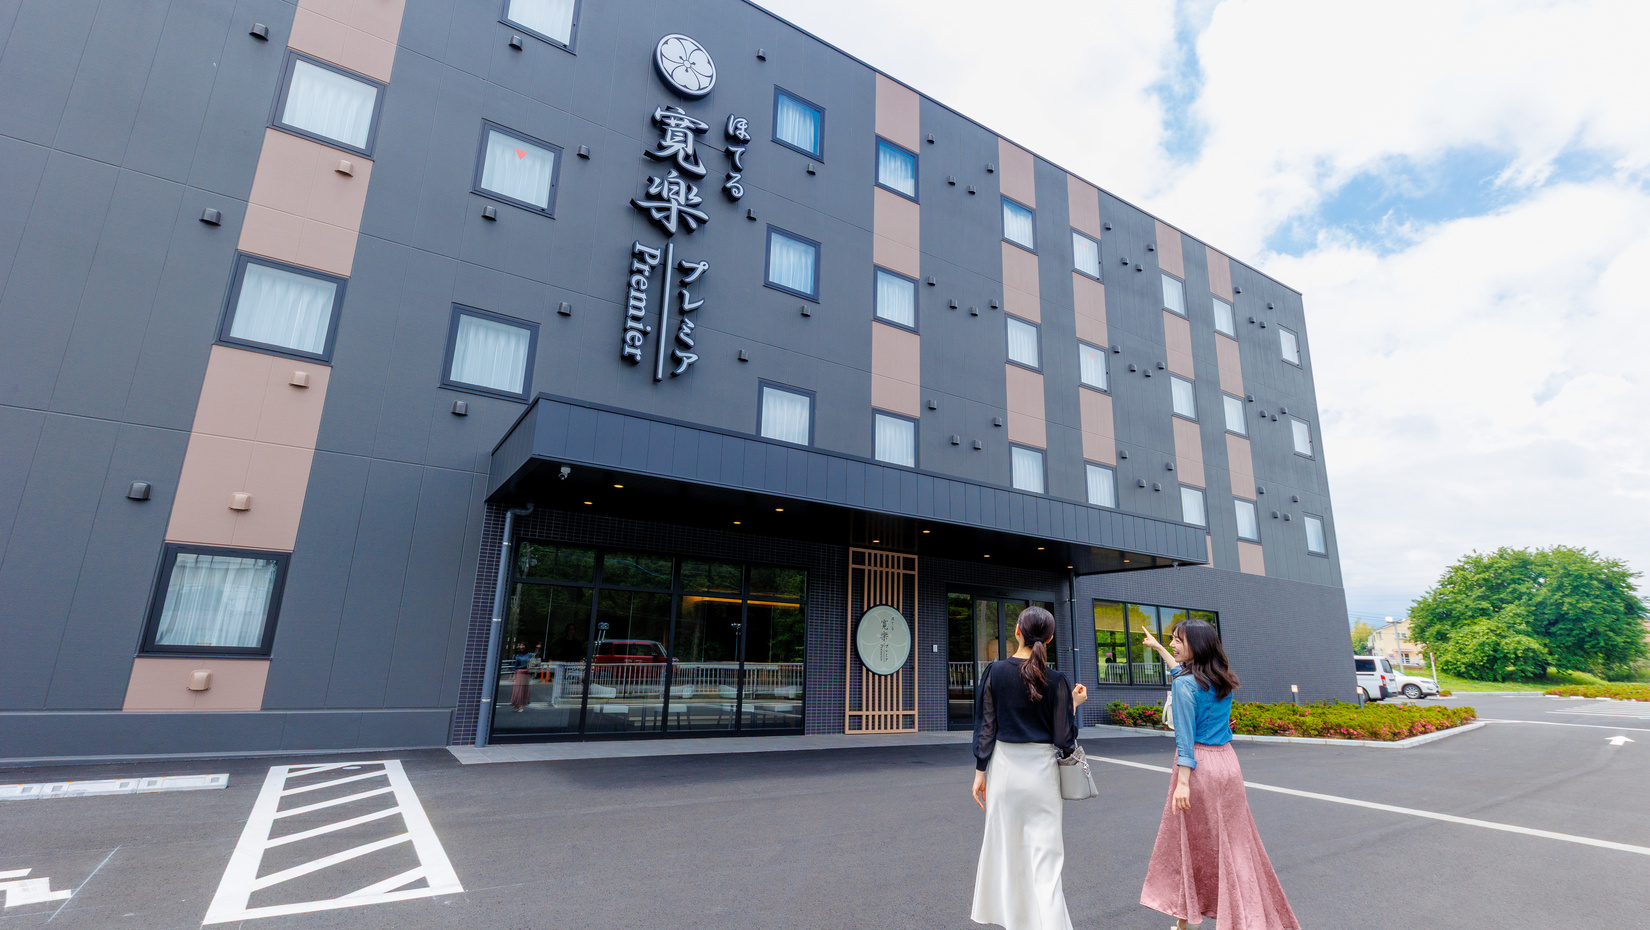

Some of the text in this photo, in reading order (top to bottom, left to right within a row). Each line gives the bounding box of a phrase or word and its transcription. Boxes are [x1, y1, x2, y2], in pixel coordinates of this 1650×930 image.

[631, 106, 710, 236] 寛楽
[722, 113, 751, 202] ほてる
[622, 240, 660, 363] Premier
[671, 259, 709, 376] プレミア
